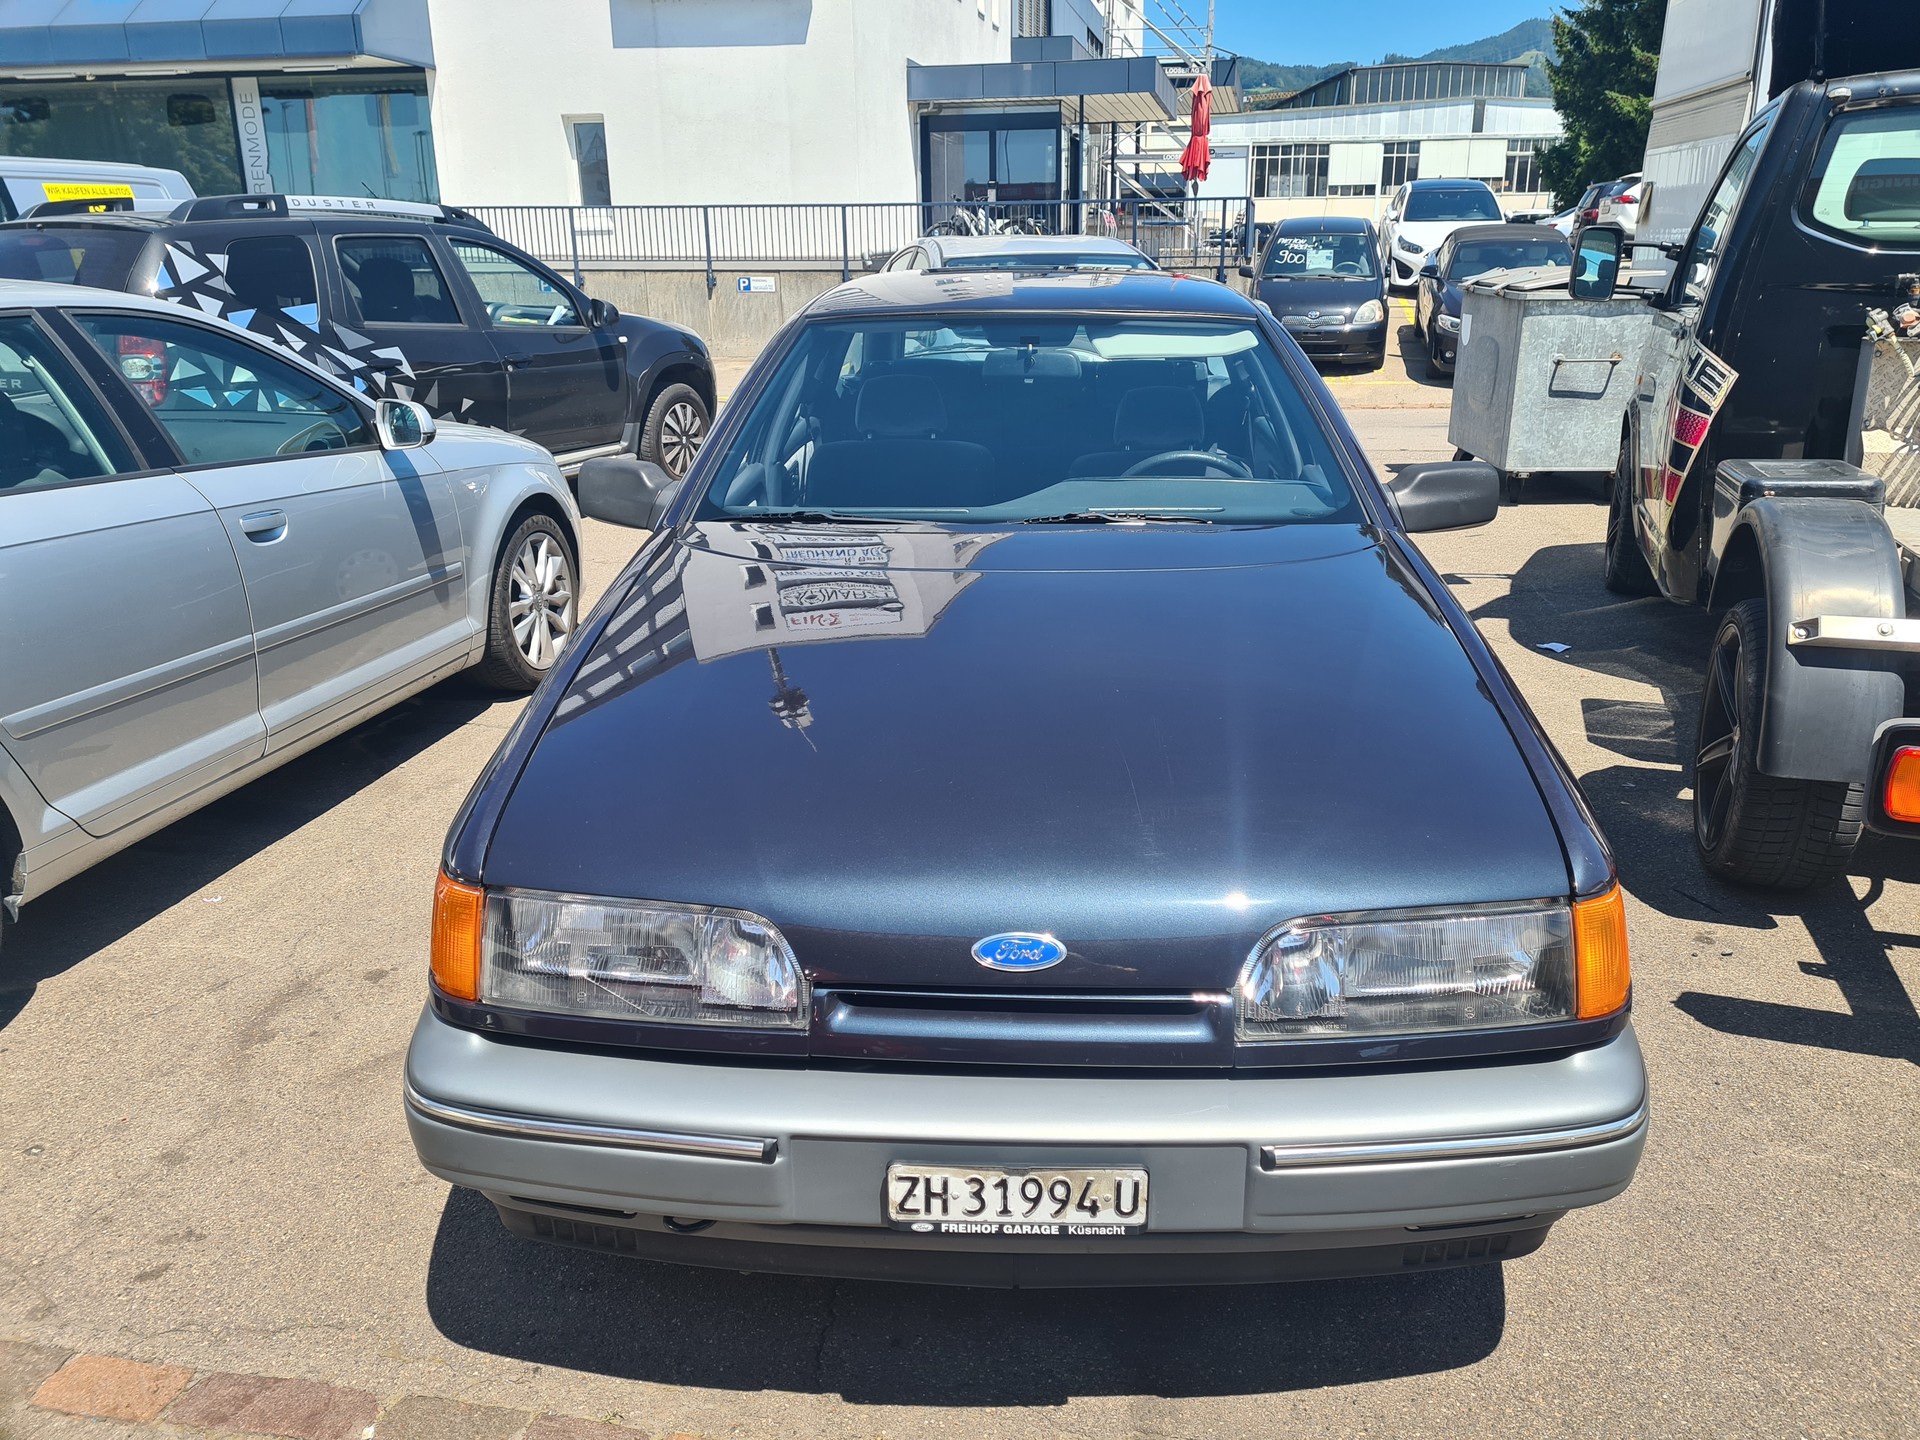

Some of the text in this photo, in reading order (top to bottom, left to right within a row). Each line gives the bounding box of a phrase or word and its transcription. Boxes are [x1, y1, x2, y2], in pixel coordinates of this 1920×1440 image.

[62, 187, 90, 195] KAUFEN
[91, 187, 108, 195] ALLE
[109, 188, 131, 196] AUTOS
[291, 198, 376, 209] DUSTER
[740, 278, 749, 291] P
[995, 939, 1045, 960] Ford
[962, 1175, 1101, 1218] 31994
[1113, 1177, 1140, 1218] U
[941, 1223, 999, 1234] FREIHOF
[1003, 1224, 1060, 1235] GARAGE
[1068, 1224, 1126, 1235] Küsnacht
